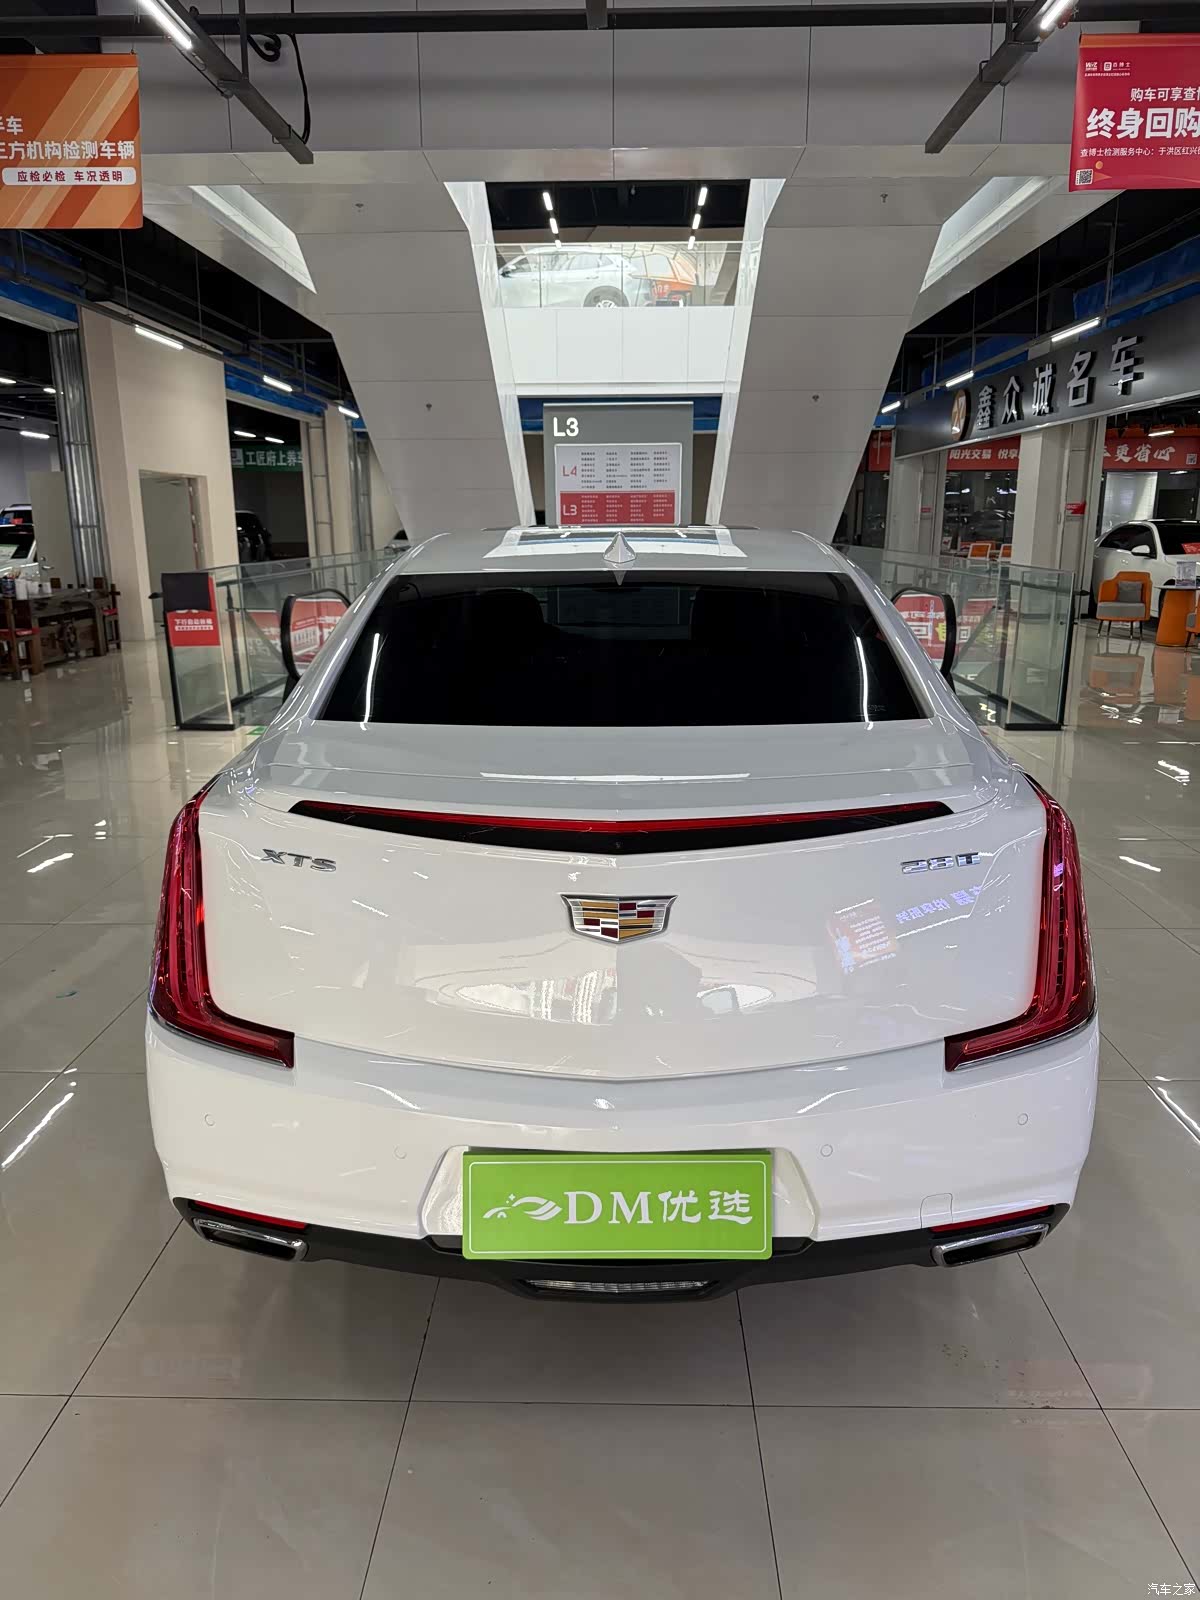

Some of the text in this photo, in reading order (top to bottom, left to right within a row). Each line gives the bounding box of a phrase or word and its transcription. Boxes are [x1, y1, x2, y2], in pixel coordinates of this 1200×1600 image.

[1131, 86, 1200, 102] 购车可享查
[1085, 106, 1200, 139] 终身回购
[1080, 146, 1200, 158] 查博士检测服务中心：于洪区红兴
[17, 171, 123, 182] 应检必检 车况透明
[976, 336, 1138, 431] 鑫众诚名车
[553, 416, 579, 437] L3
[949, 448, 1020, 459] 阳光交易 悦享
[562, 465, 577, 477] L4
[562, 504, 578, 516] L3
[260, 848, 337, 873] XTS
[900, 851, 981, 874] 28T
[563, 1190, 753, 1225] DM优选
